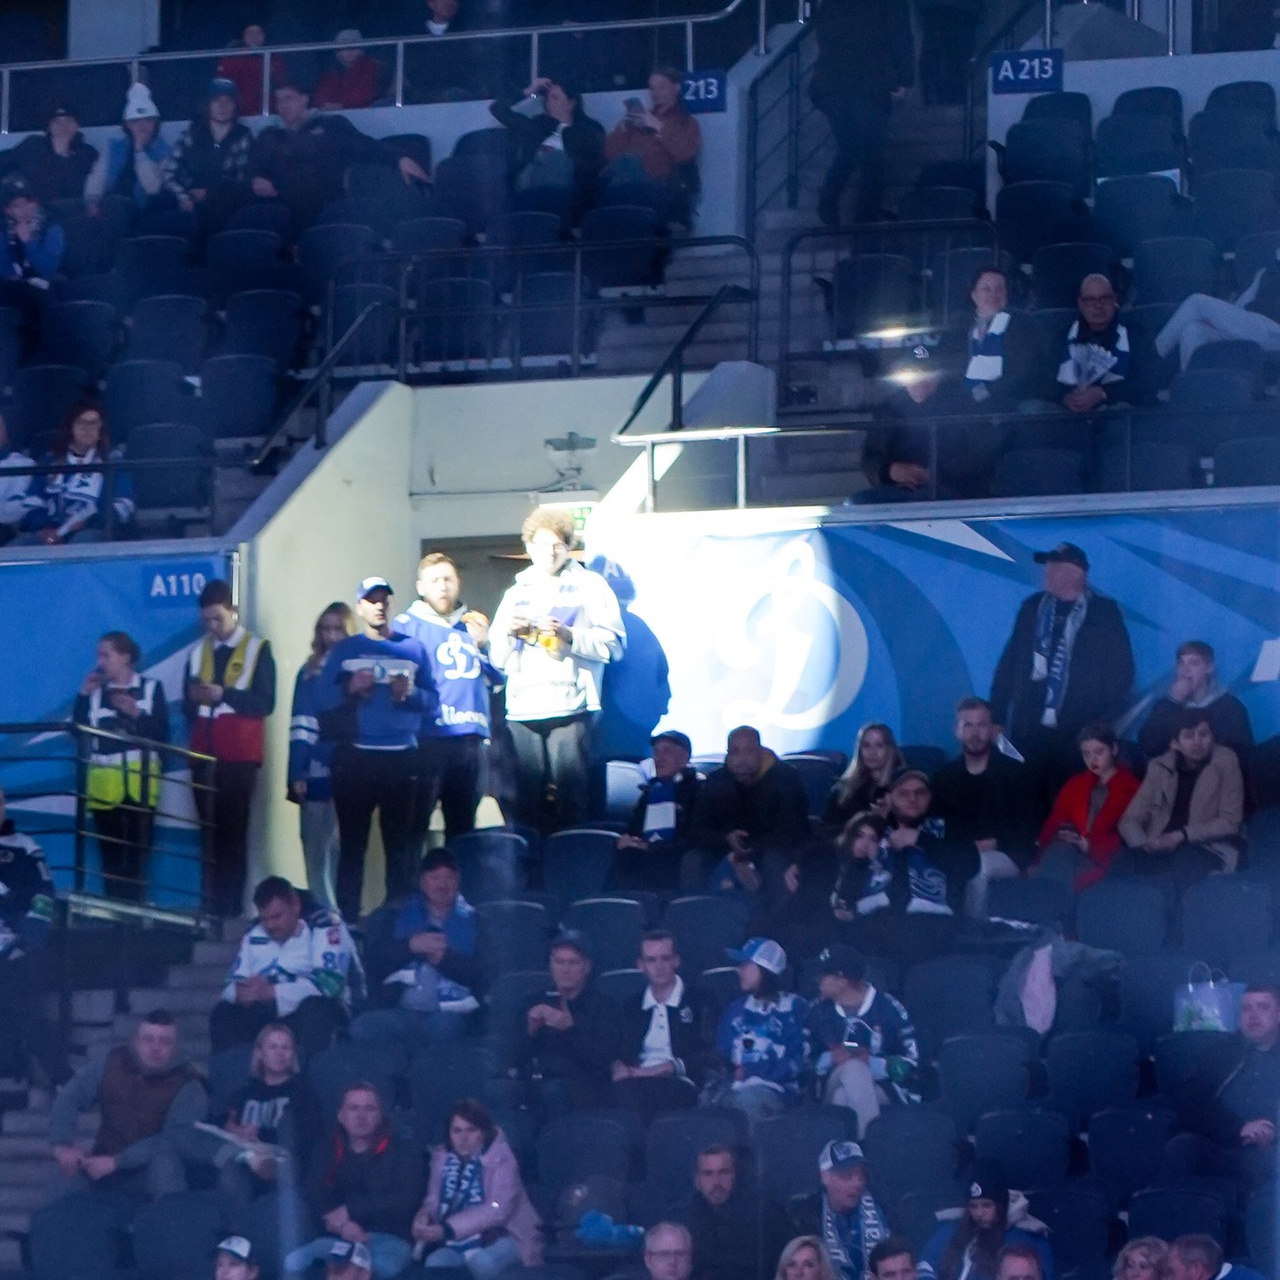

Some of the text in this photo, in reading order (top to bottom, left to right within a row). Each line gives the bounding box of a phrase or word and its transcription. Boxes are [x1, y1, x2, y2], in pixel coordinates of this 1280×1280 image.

[1019, 57, 1053, 80] 213
[684, 77, 718, 101] 213
[150, 572, 207, 597] A110
